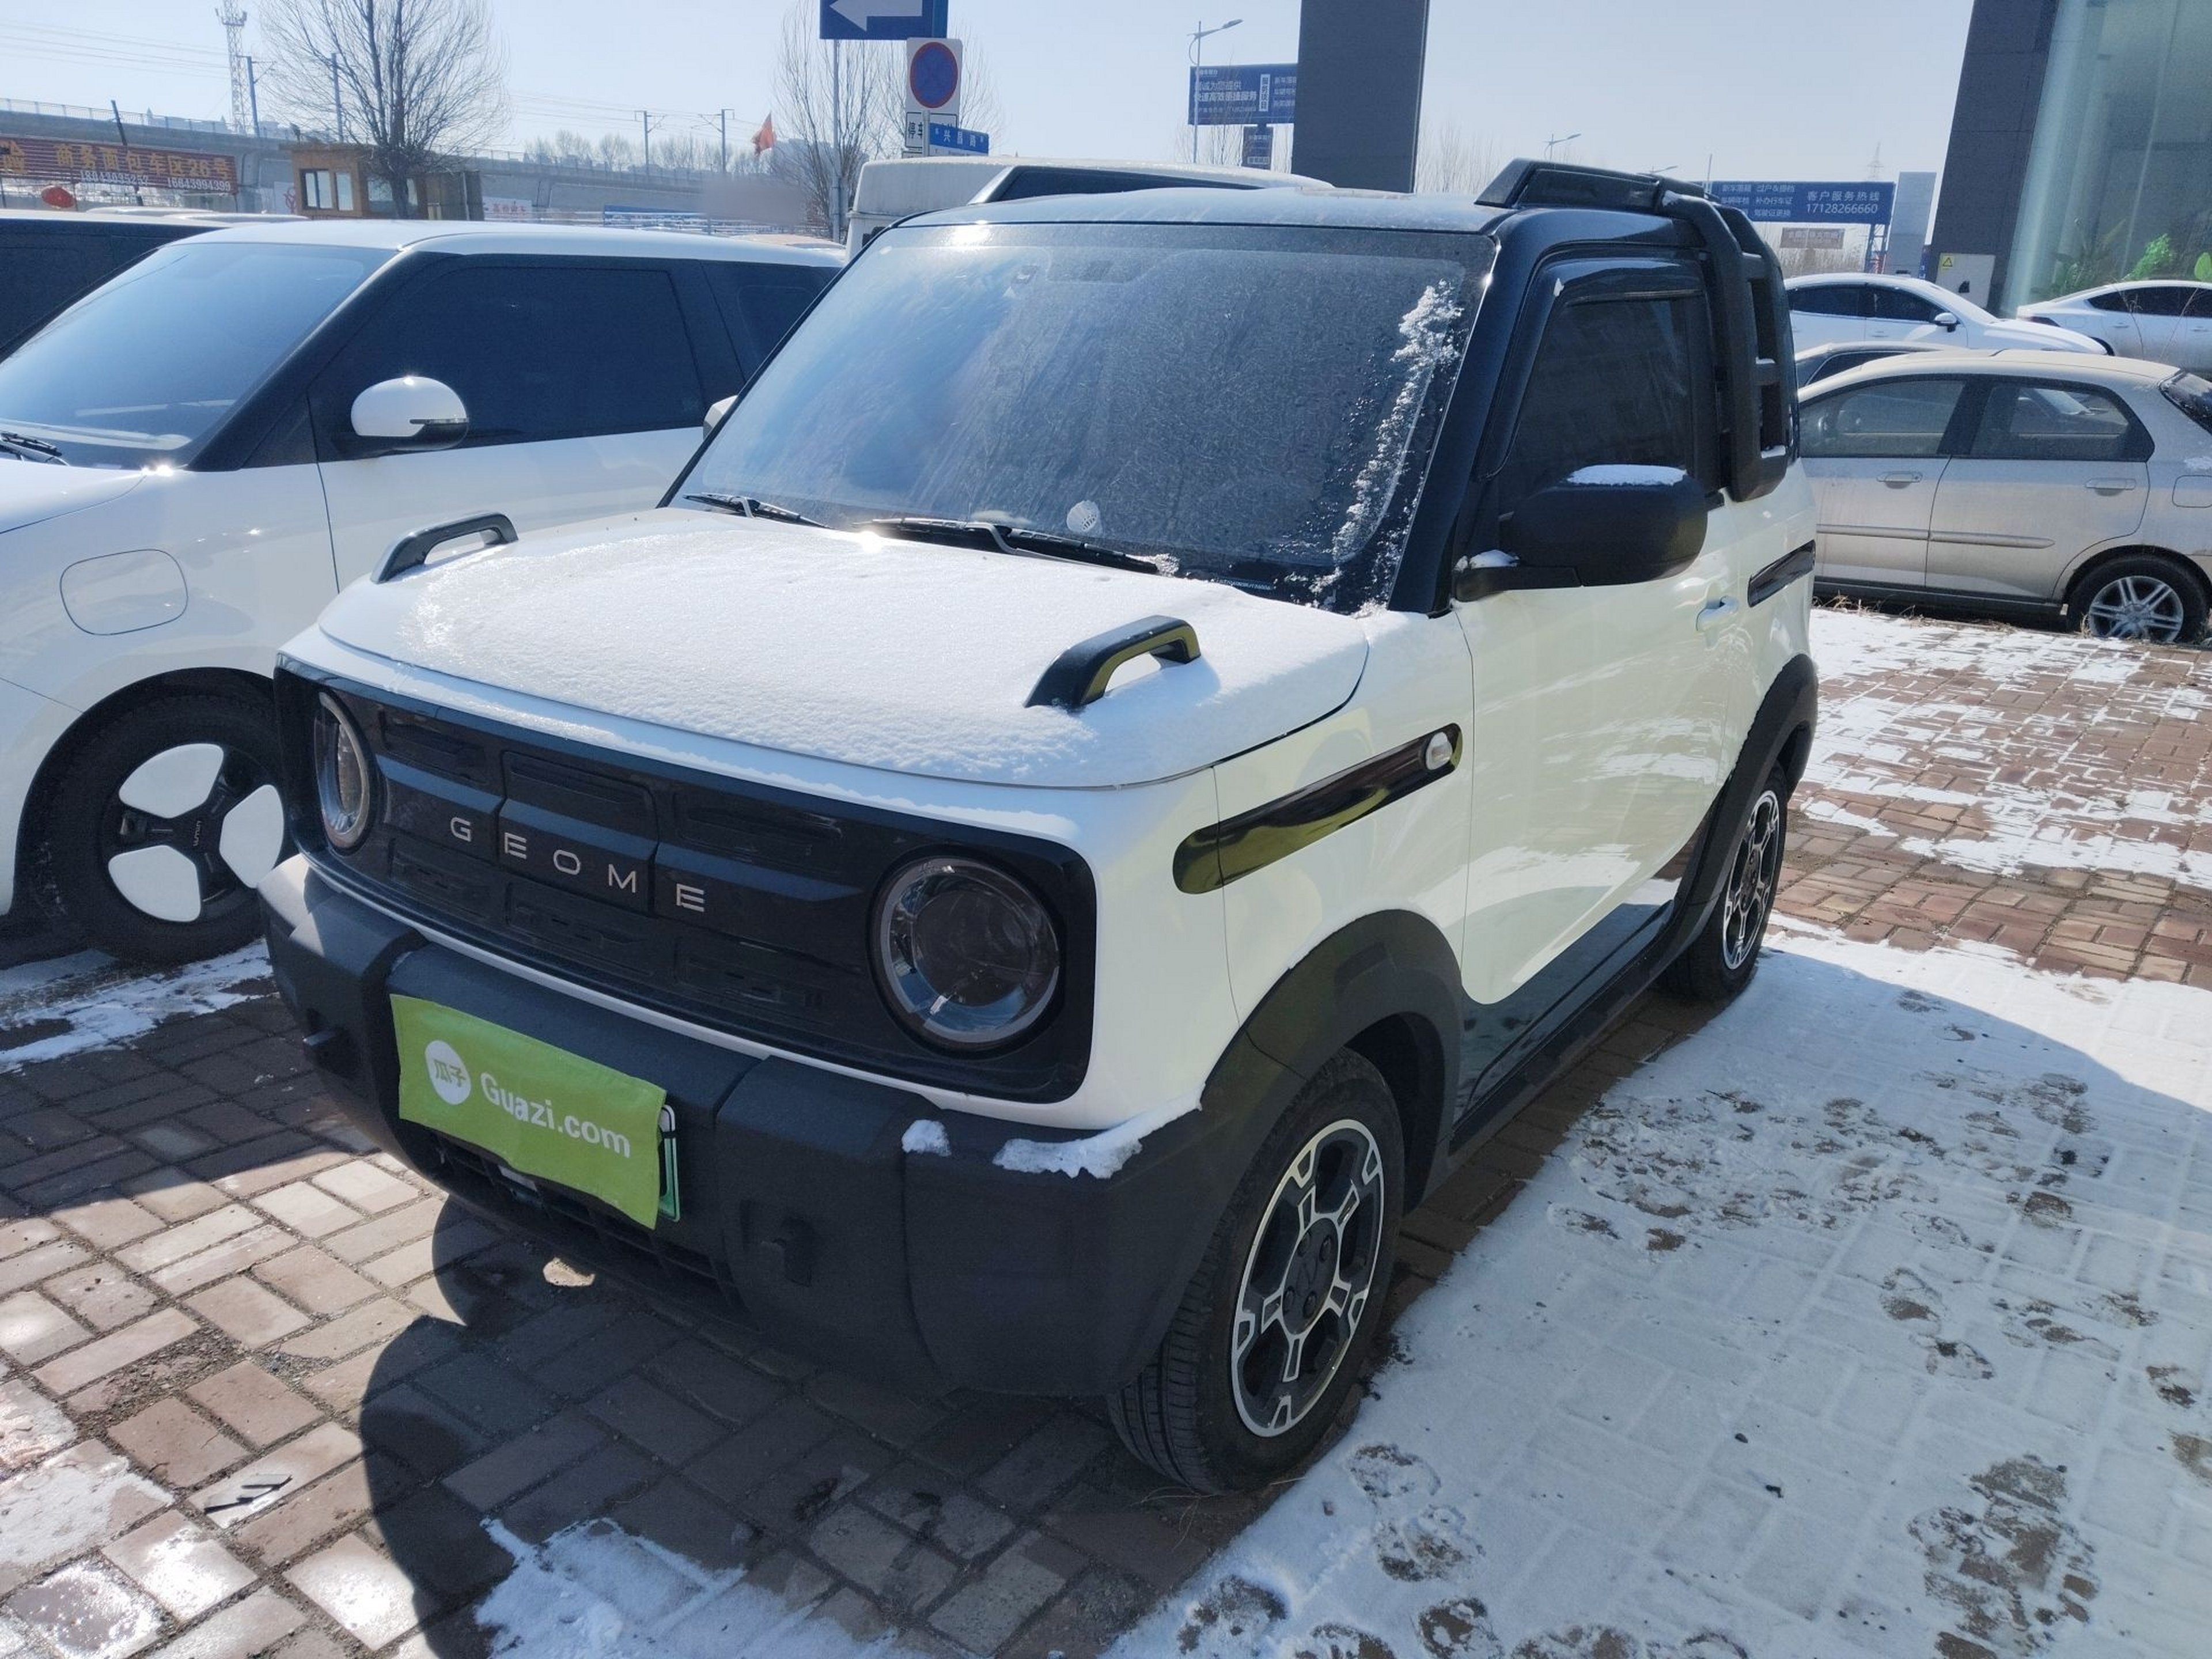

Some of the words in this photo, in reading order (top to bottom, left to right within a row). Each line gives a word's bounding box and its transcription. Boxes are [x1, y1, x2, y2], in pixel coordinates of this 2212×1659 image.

[1806, 203, 1878, 214] 17128266660
[1807, 191, 1880, 201] 客户服务热线
[450, 816, 705, 912] GEOME
[433, 1058, 467, 1088] 瓜子
[480, 1072, 631, 1158] Guazi.com
